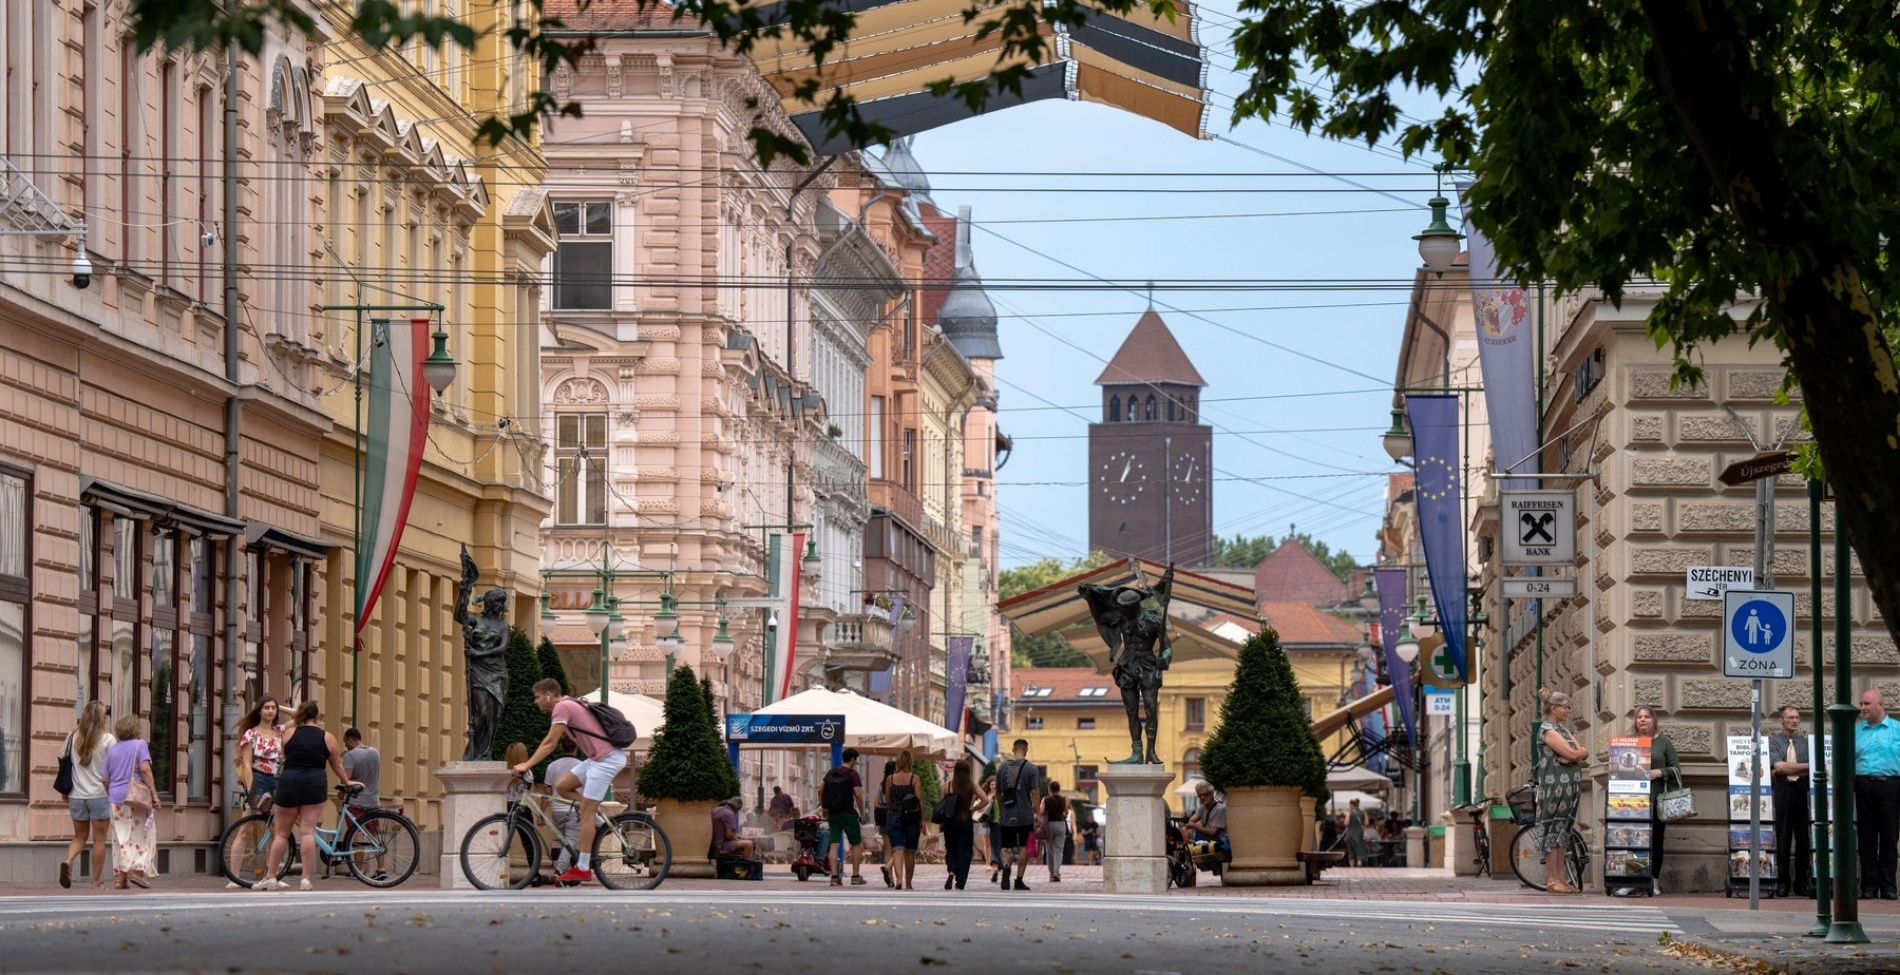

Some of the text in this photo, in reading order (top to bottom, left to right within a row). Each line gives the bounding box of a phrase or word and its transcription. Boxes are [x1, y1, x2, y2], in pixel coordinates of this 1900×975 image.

[1511, 501, 1563, 509] RAIFFEISEN
[1526, 548, 1551, 556] BANK
[1691, 567, 1752, 582] SZÉCHENYI
[1526, 583, 1550, 592] 0-24
[1715, 582, 1728, 590] TÉR
[1739, 658, 1777, 670] ZÓNA
[750, 724, 815, 733] SZEGEDI VÍZMŰ ZRT.
